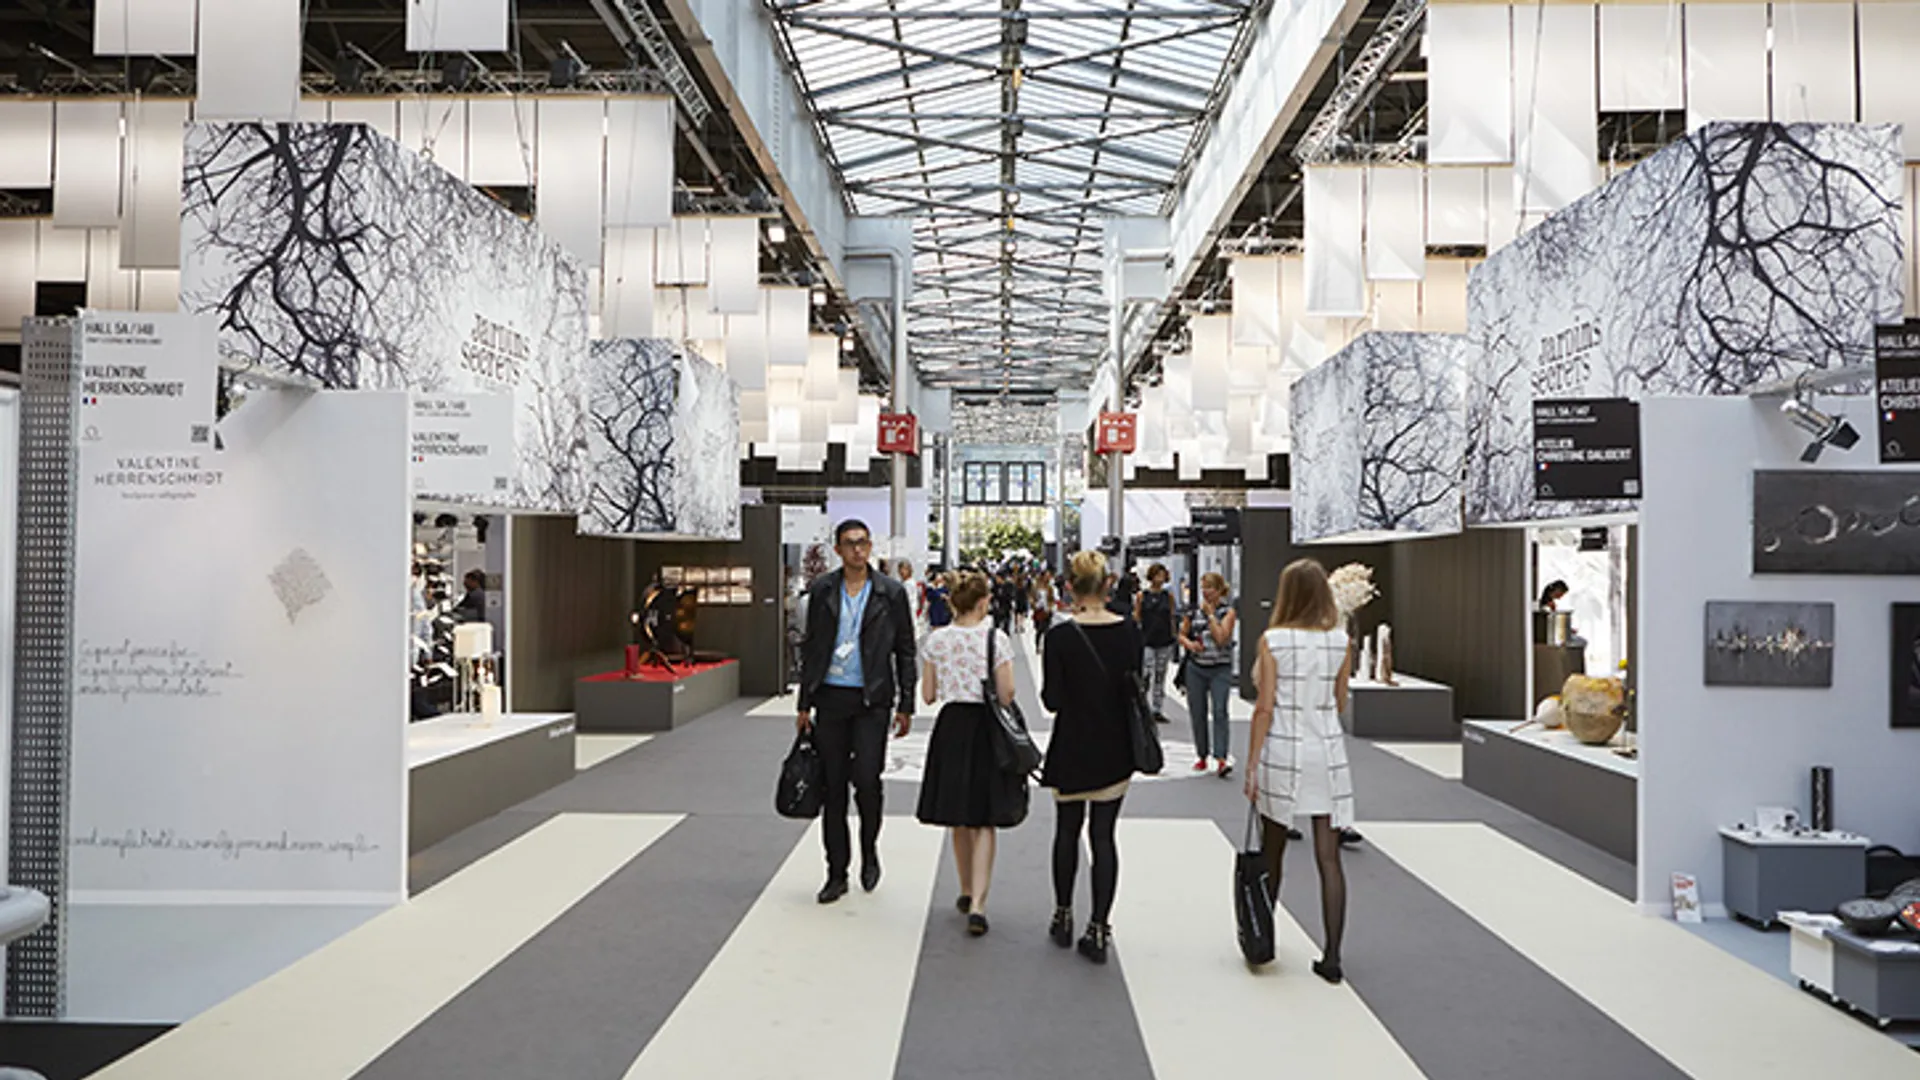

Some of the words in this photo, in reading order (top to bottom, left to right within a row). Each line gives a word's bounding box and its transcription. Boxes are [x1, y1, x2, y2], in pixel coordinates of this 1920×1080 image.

[84, 322, 112, 335] HALL
[114, 322, 129, 335] 5A
[1878, 334, 1905, 349] HALL
[84, 365, 148, 379] VALENTINE
[82, 381, 185, 397] HERRENSCHMIDT
[116, 456, 201, 470] VALENTINE
[94, 470, 224, 486] HERRENSCHMIDT
